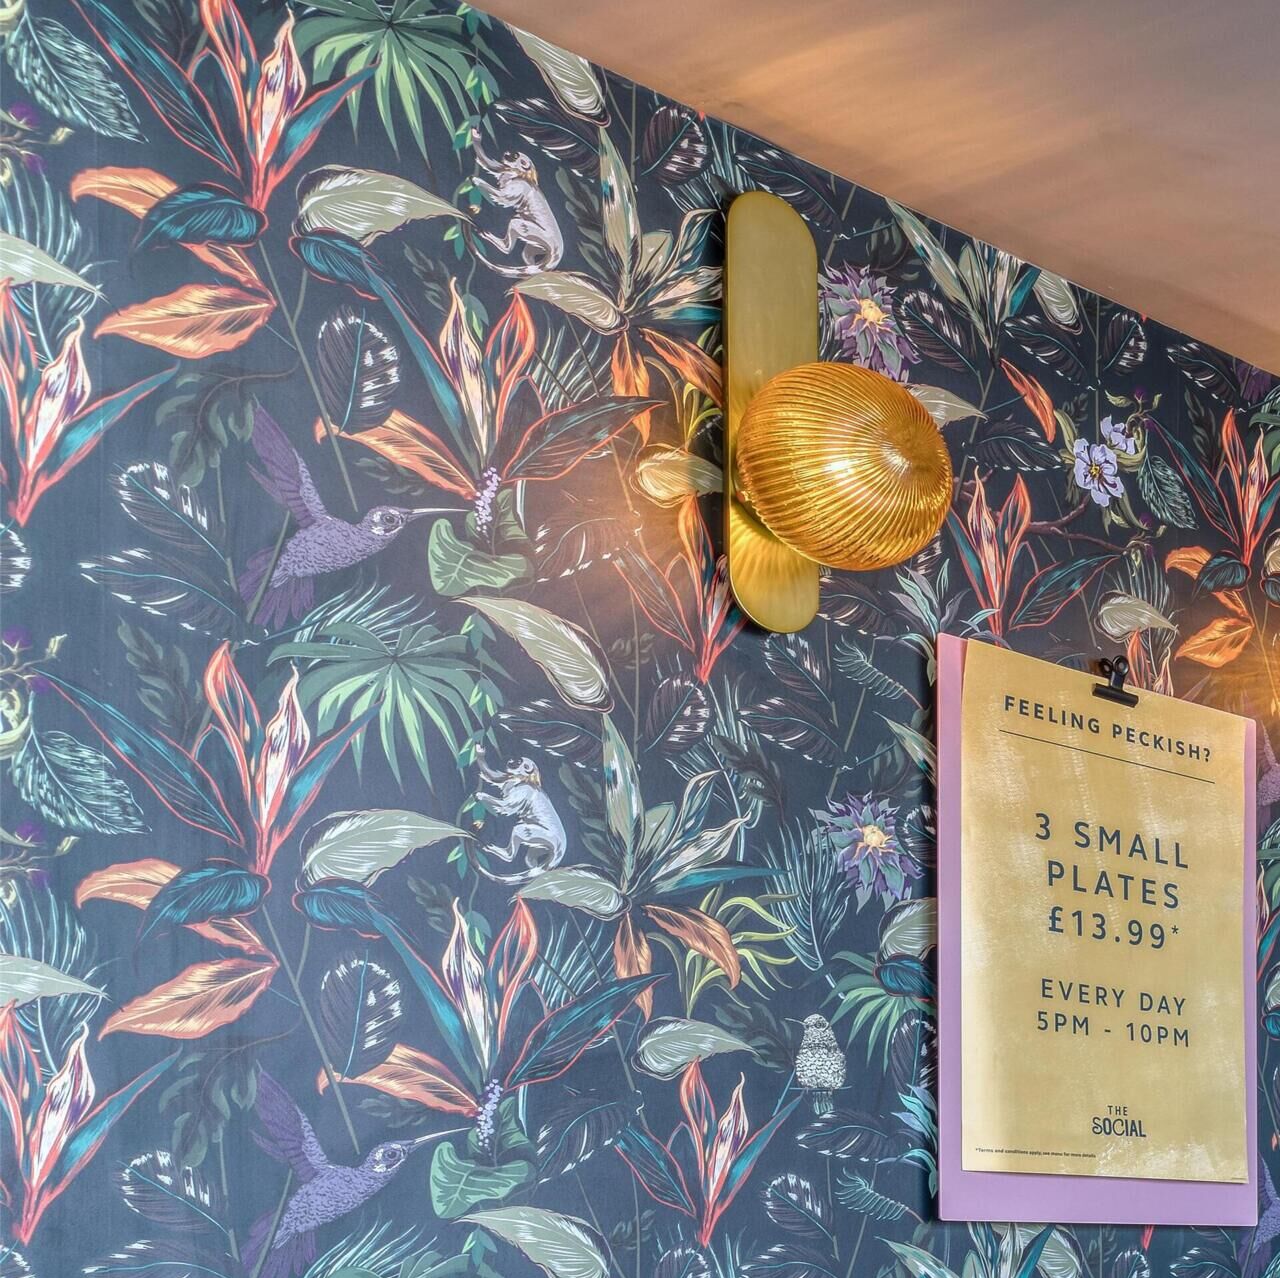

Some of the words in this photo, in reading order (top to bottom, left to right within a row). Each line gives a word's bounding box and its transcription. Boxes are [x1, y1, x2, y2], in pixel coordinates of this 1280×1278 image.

[1004, 695, 1100, 733] FEELING
[1112, 723, 1211, 762] PECKISH?
[1035, 813, 1051, 840] 3
[1074, 821, 1188, 869] SMALL
[1047, 860, 1179, 909] PLATES
[1041, 978, 1125, 1008] EVERY
[1140, 992, 1186, 1016] DAY
[1037, 1011, 1089, 1036] 5PM
[1126, 1022, 1189, 1048] 10PM
[1092, 1117, 1147, 1138] SOCIAL
[1107, 1105, 1128, 1117] THE
